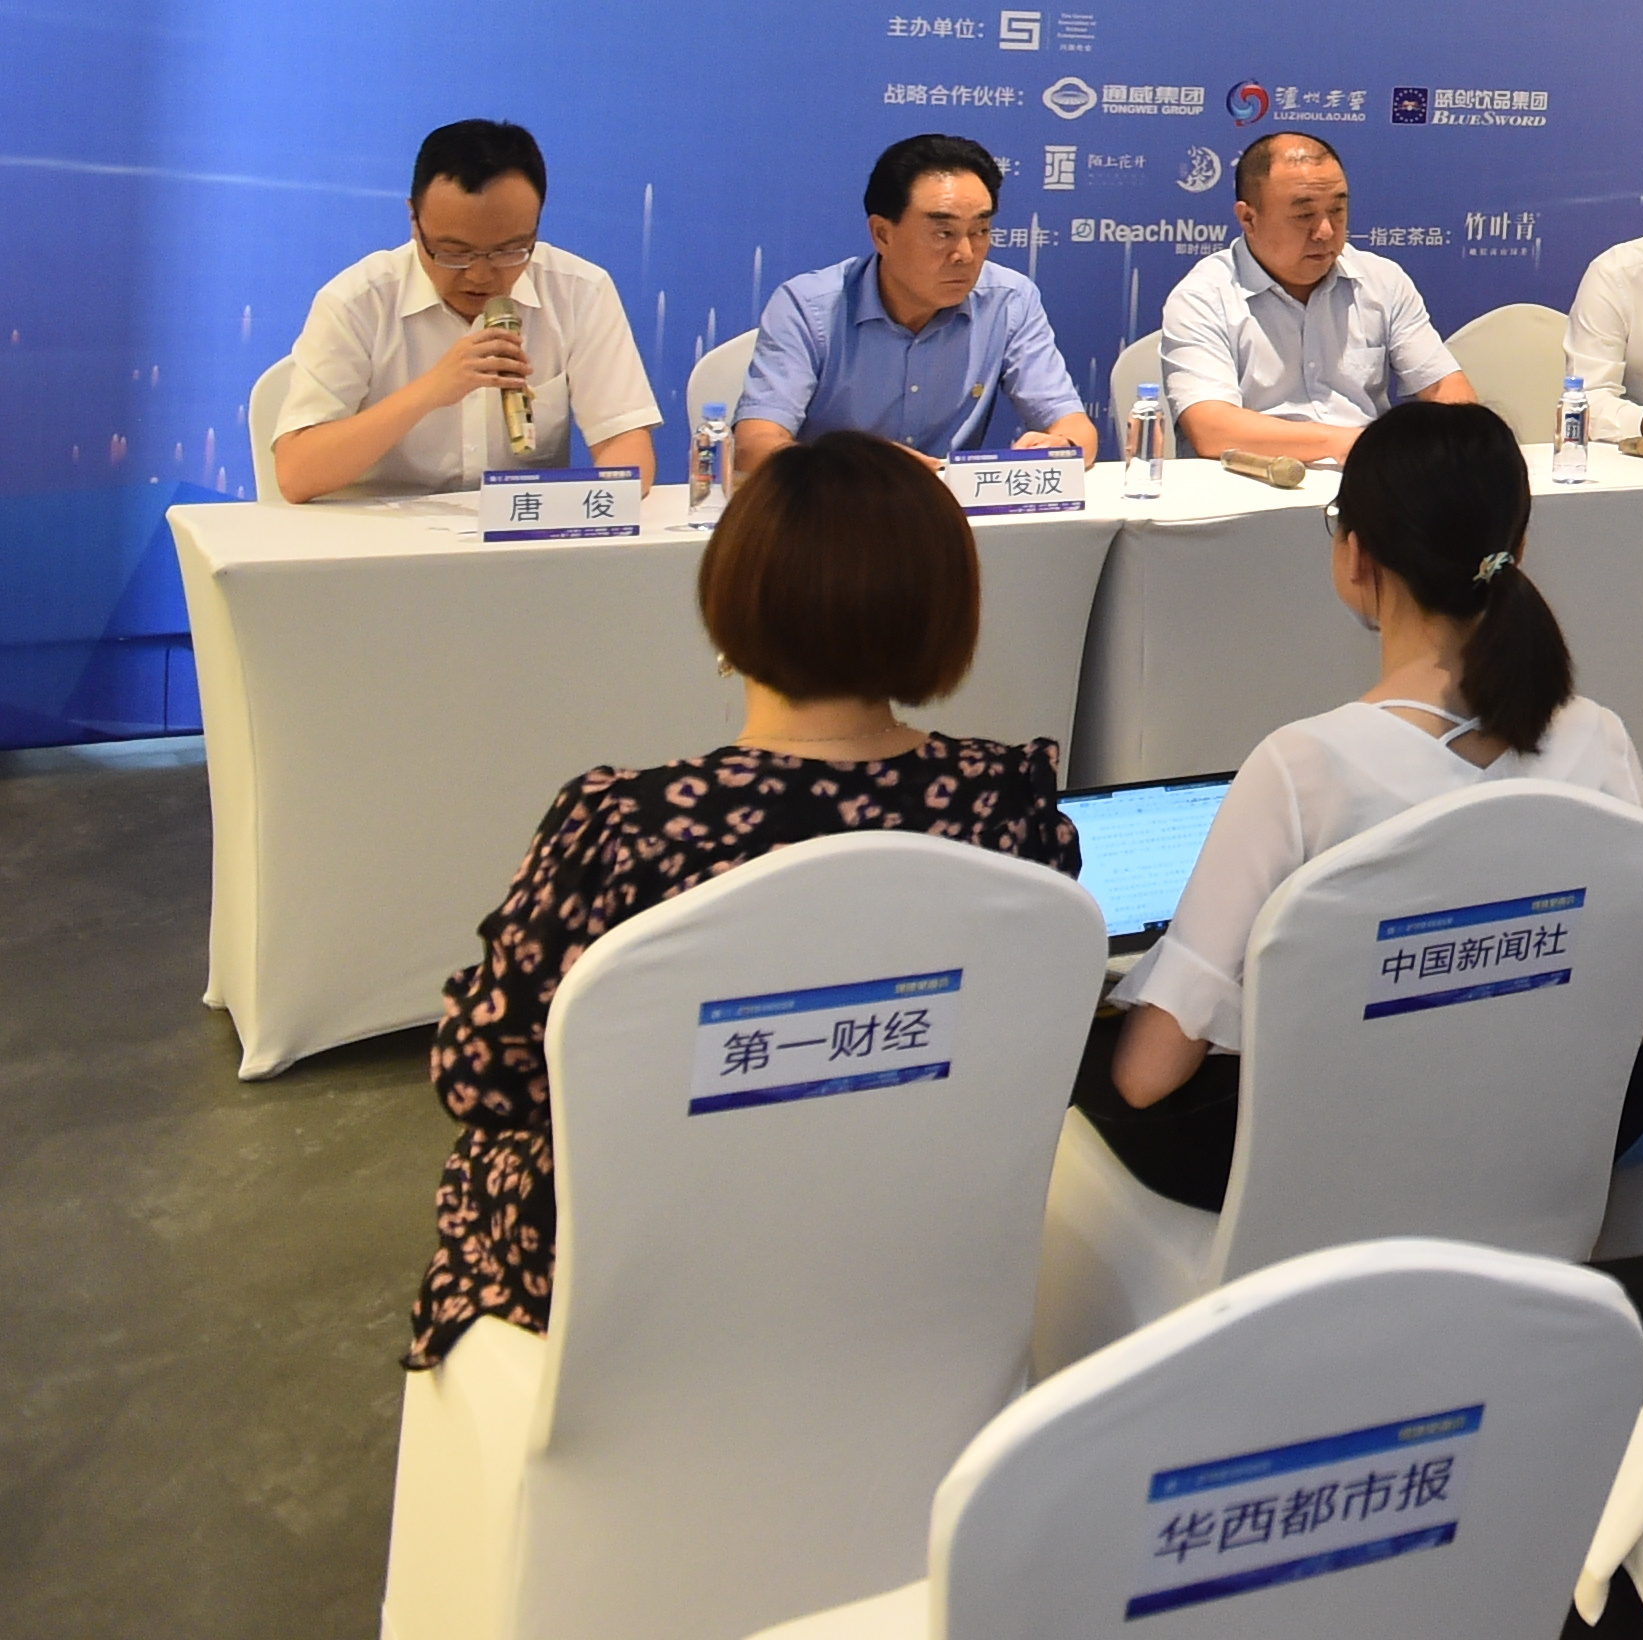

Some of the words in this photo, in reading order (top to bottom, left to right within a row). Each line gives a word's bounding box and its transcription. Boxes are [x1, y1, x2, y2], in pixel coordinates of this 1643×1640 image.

[1102, 84, 1205, 105] 通威集团
[1102, 104, 1157, 114] TONGWEI
[1161, 105, 1204, 116] GROUP
[1100, 219, 1229, 242] ReachNow
[1345, 227, 1451, 247] 一指定茶品：
[1465, 211, 1536, 240] 竹叶青
[974, 467, 1063, 498] 严俊波
[510, 489, 615, 522] 唐俊
[1381, 922, 1569, 985] 中国新闻社
[720, 1009, 932, 1076] 第一财经
[1154, 1456, 1454, 1564] 华西都市报
